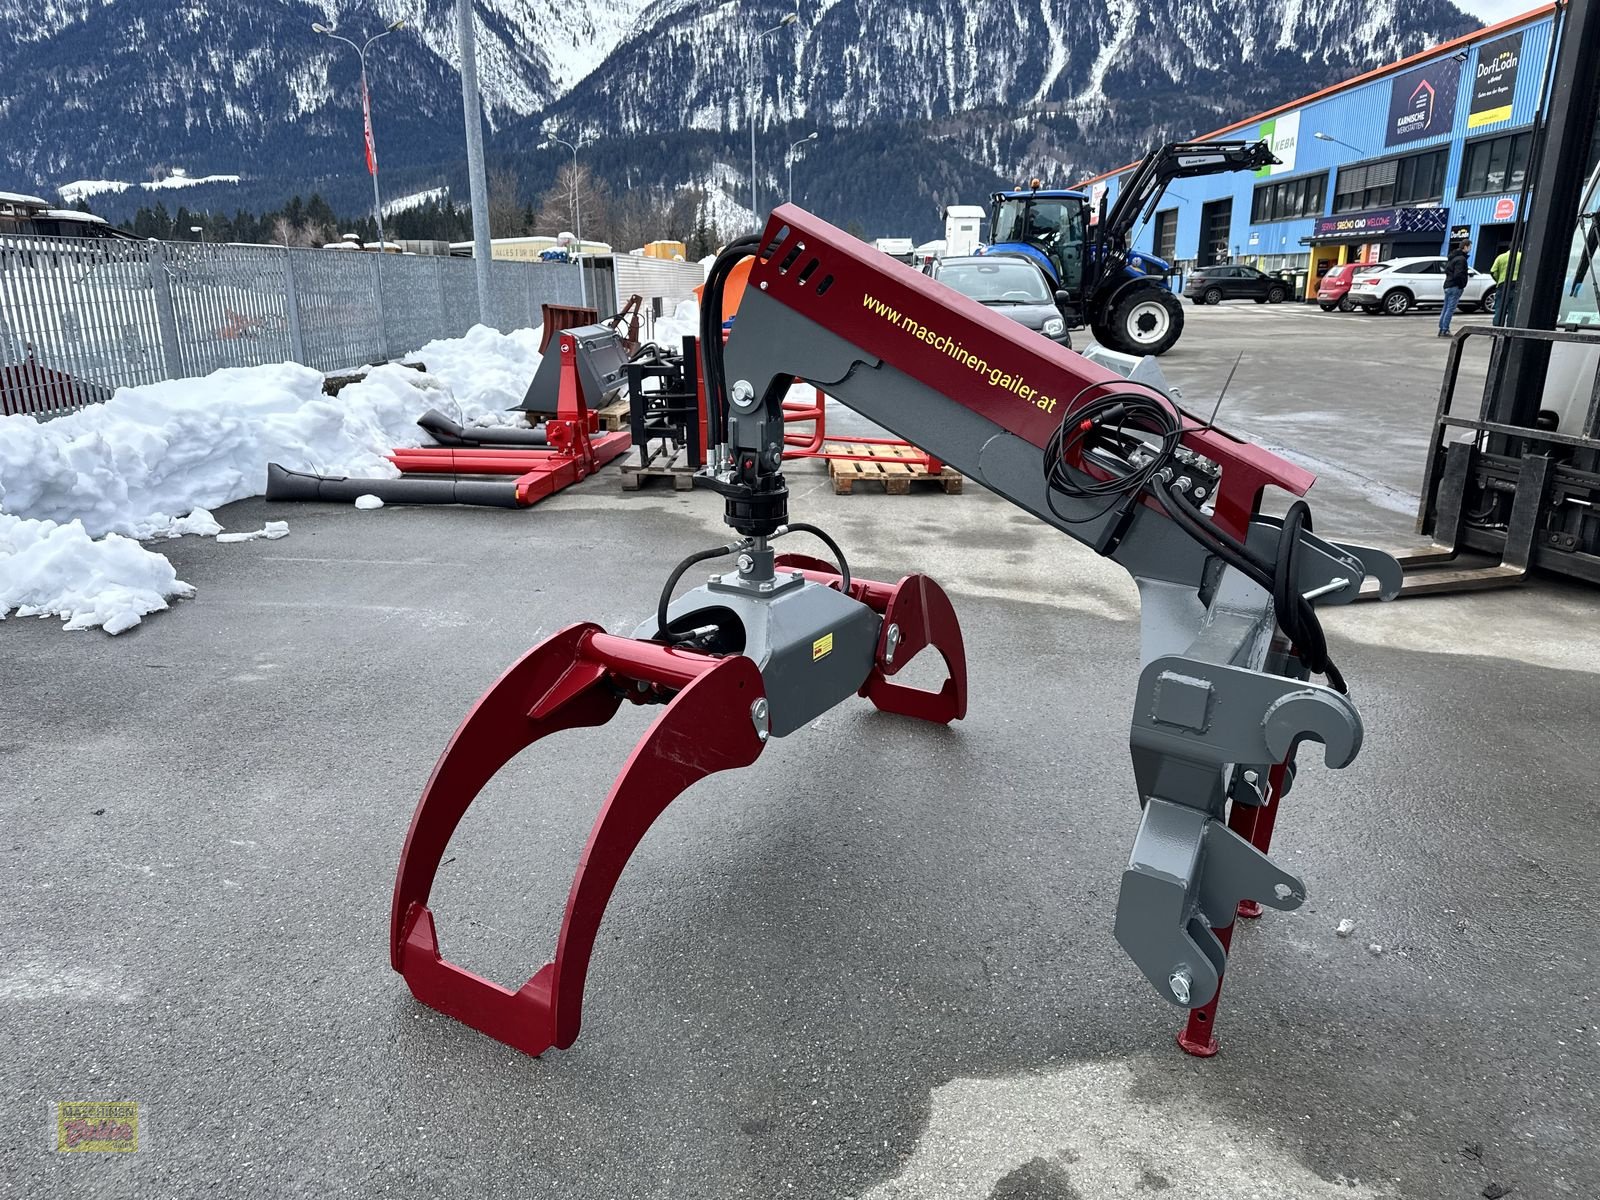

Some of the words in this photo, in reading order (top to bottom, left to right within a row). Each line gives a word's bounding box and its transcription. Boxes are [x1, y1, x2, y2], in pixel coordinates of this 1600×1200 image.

[1477, 51, 1518, 78] DorfLodn
[1397, 111, 1426, 127] KARNISCHE
[1321, 220, 1337, 231] SERVUS
[1366, 216, 1391, 227] WELCOME
[862, 293, 1057, 414] www.maschinen-gailer.at
